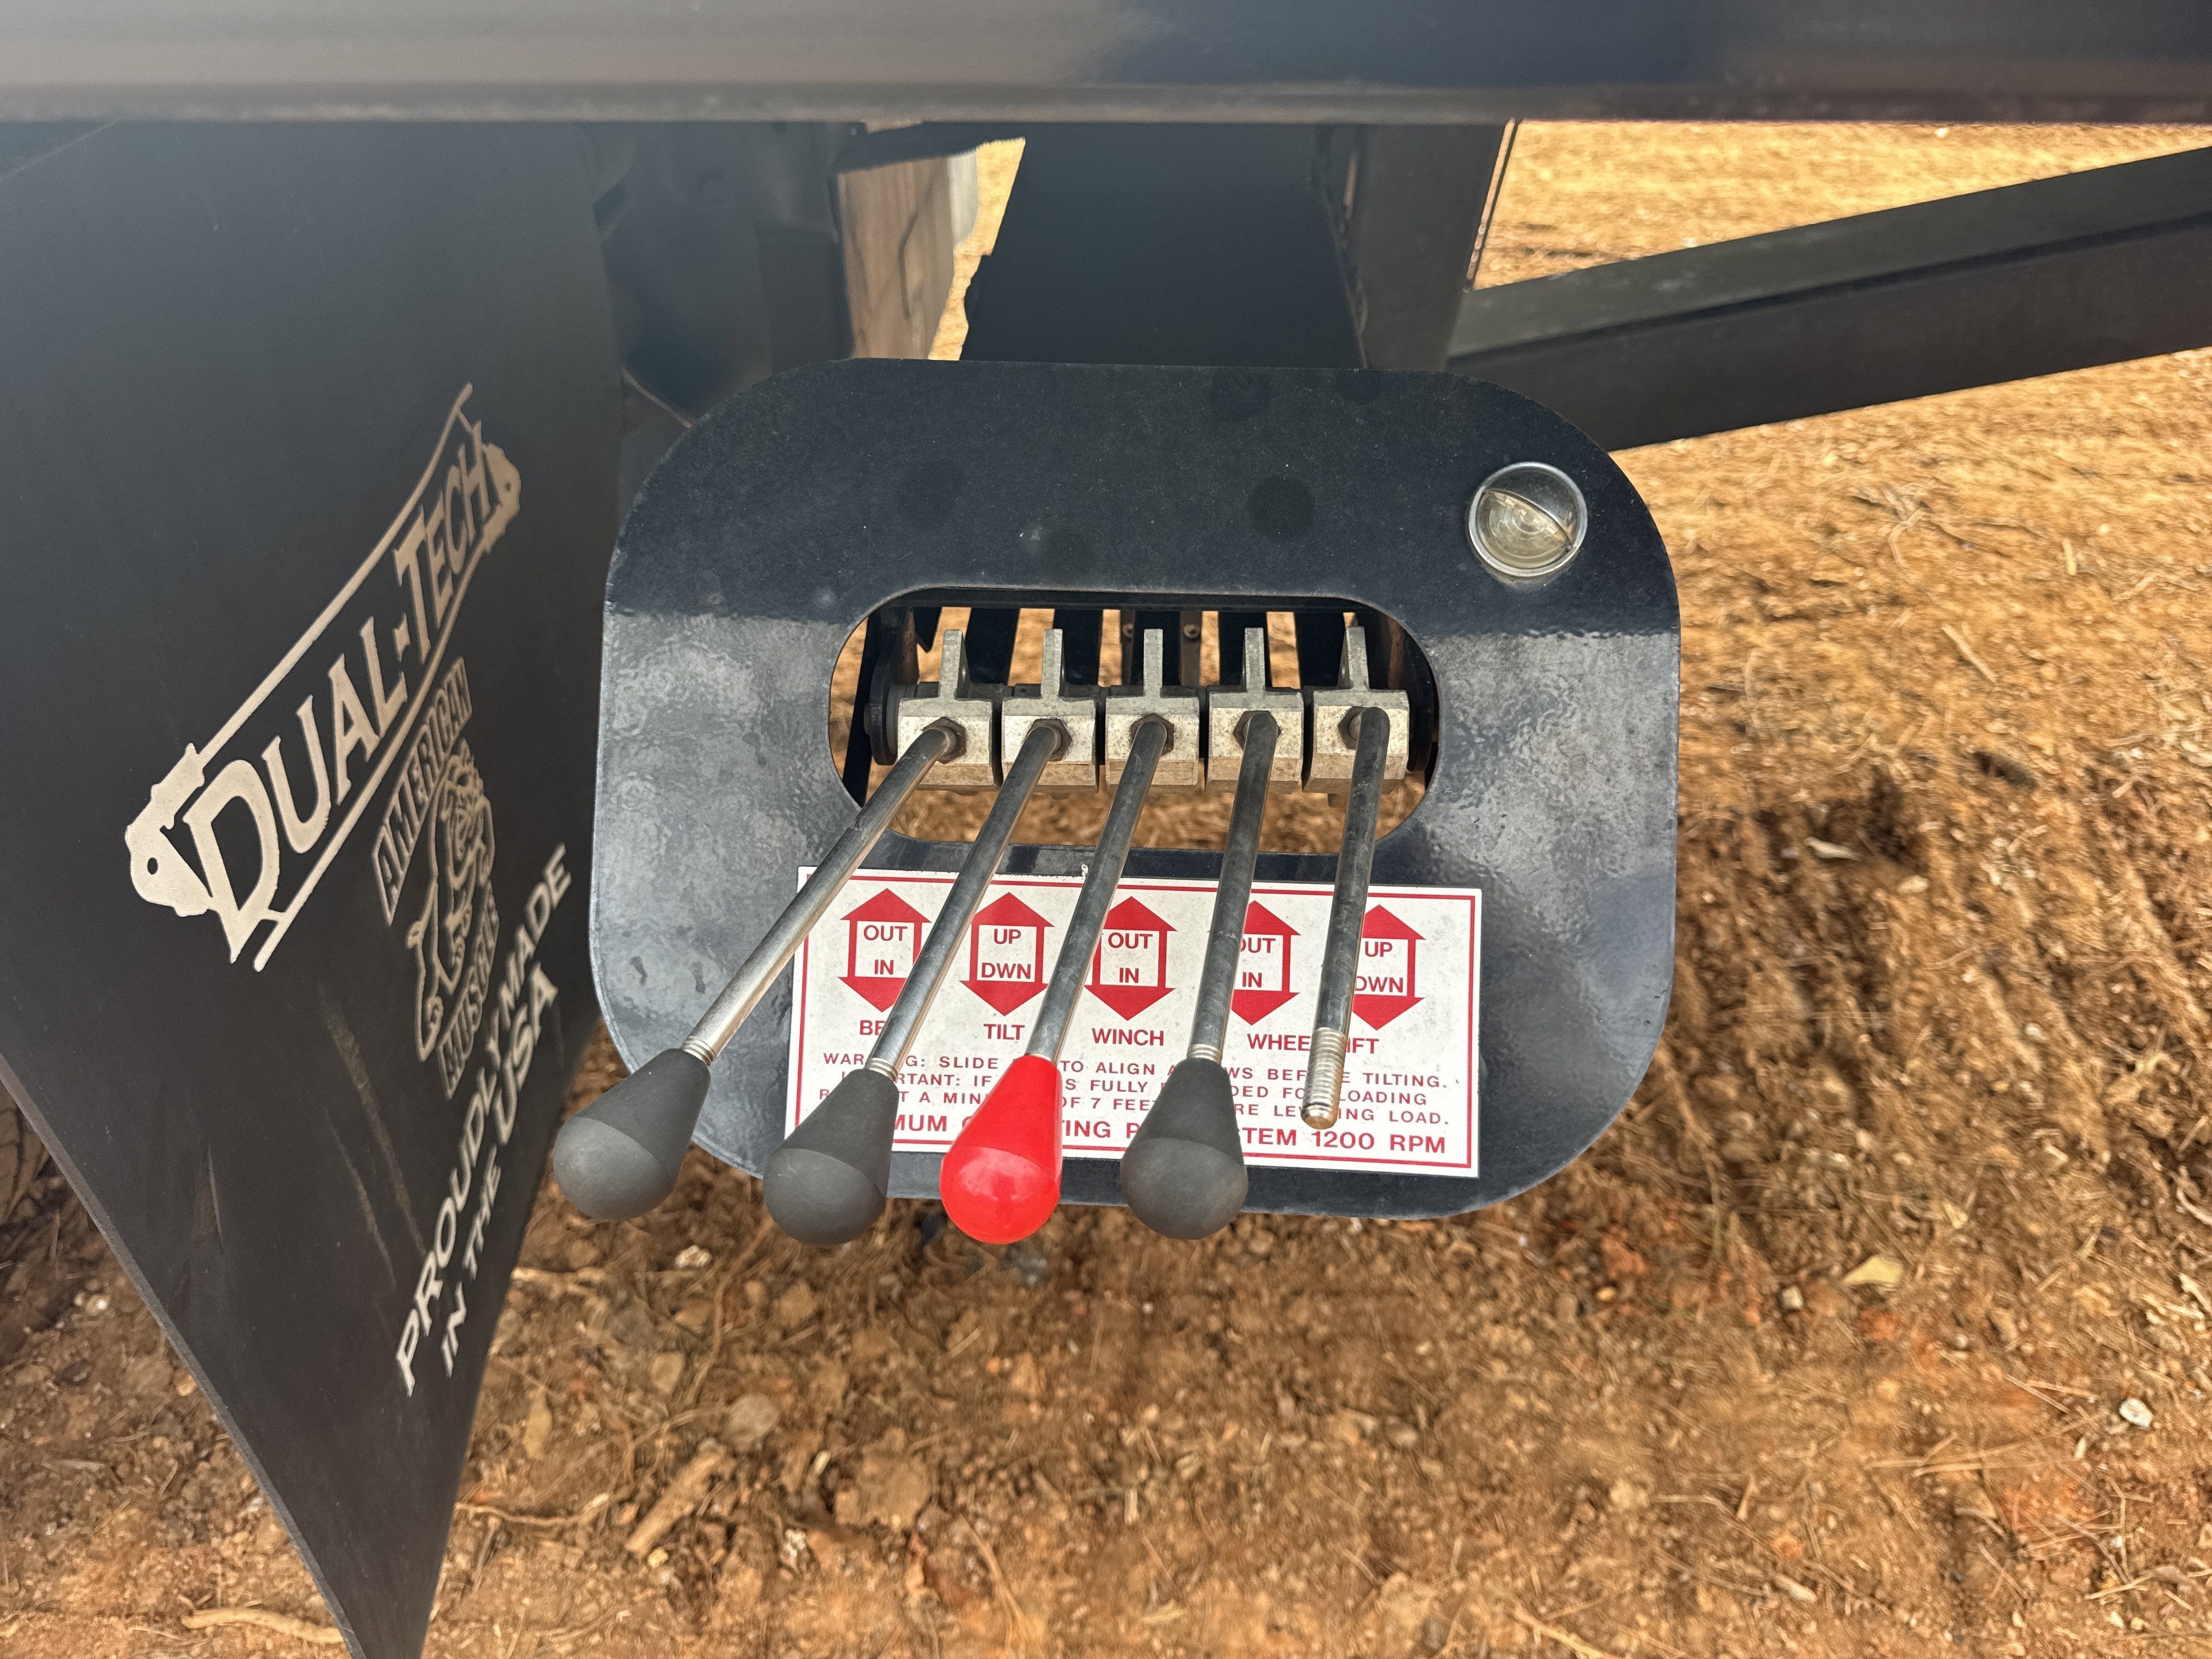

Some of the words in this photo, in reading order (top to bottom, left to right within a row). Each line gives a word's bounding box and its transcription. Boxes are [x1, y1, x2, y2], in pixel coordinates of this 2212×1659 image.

[183, 420, 492, 964] DUAL-TECH
[373, 657, 473, 924] AMERICAN
[863, 924, 908, 942] OUT
[993, 929, 1022, 945] UP
[1108, 932, 1153, 949] OUT
[1364, 941, 1393, 957] UP
[874, 959, 894, 975] IN
[981, 963, 1031, 979] DWN
[1119, 967, 1139, 984] IN
[1242, 972, 1262, 988] IN
[859, 1019, 886, 1036] BE
[983, 1024, 1025, 1041] TILT
[1092, 1028, 1165, 1046] WINCH
[1248, 1034, 1311, 1052] WHEE
[1346, 1037, 1379, 1054] IFT
[823, 1053, 926, 1068] WARG:
[939, 1056, 998, 1070] SLIDE
[1060, 1060, 1085, 1073] TO
[1095, 1062, 1155, 1076] ALIGN
[1267, 1068, 1351, 1084] BEFE
[1363, 1072, 1447, 1088] TILTING.
[974, 1075, 992, 1087] IF
[1090, 1079, 1148, 1093] FULLY
[1339, 1089, 1427, 1105] OADING
[919, 1091, 931, 1104] A
[1091, 1098, 1102, 1110] 7
[1113, 1098, 1155, 1111] FEE
[1389, 1110, 1449, 1125] LOAD.
[395, 1007, 501, 1397] PROUDLY
[498, 843, 572, 1034] MADE
[1311, 1130, 1375, 1150] 1200
[1390, 1134, 1446, 1154] RPM
[441, 1282, 467, 1378] IN
[462, 1145, 501, 1281] THE
[494, 962, 559, 1147] USA
